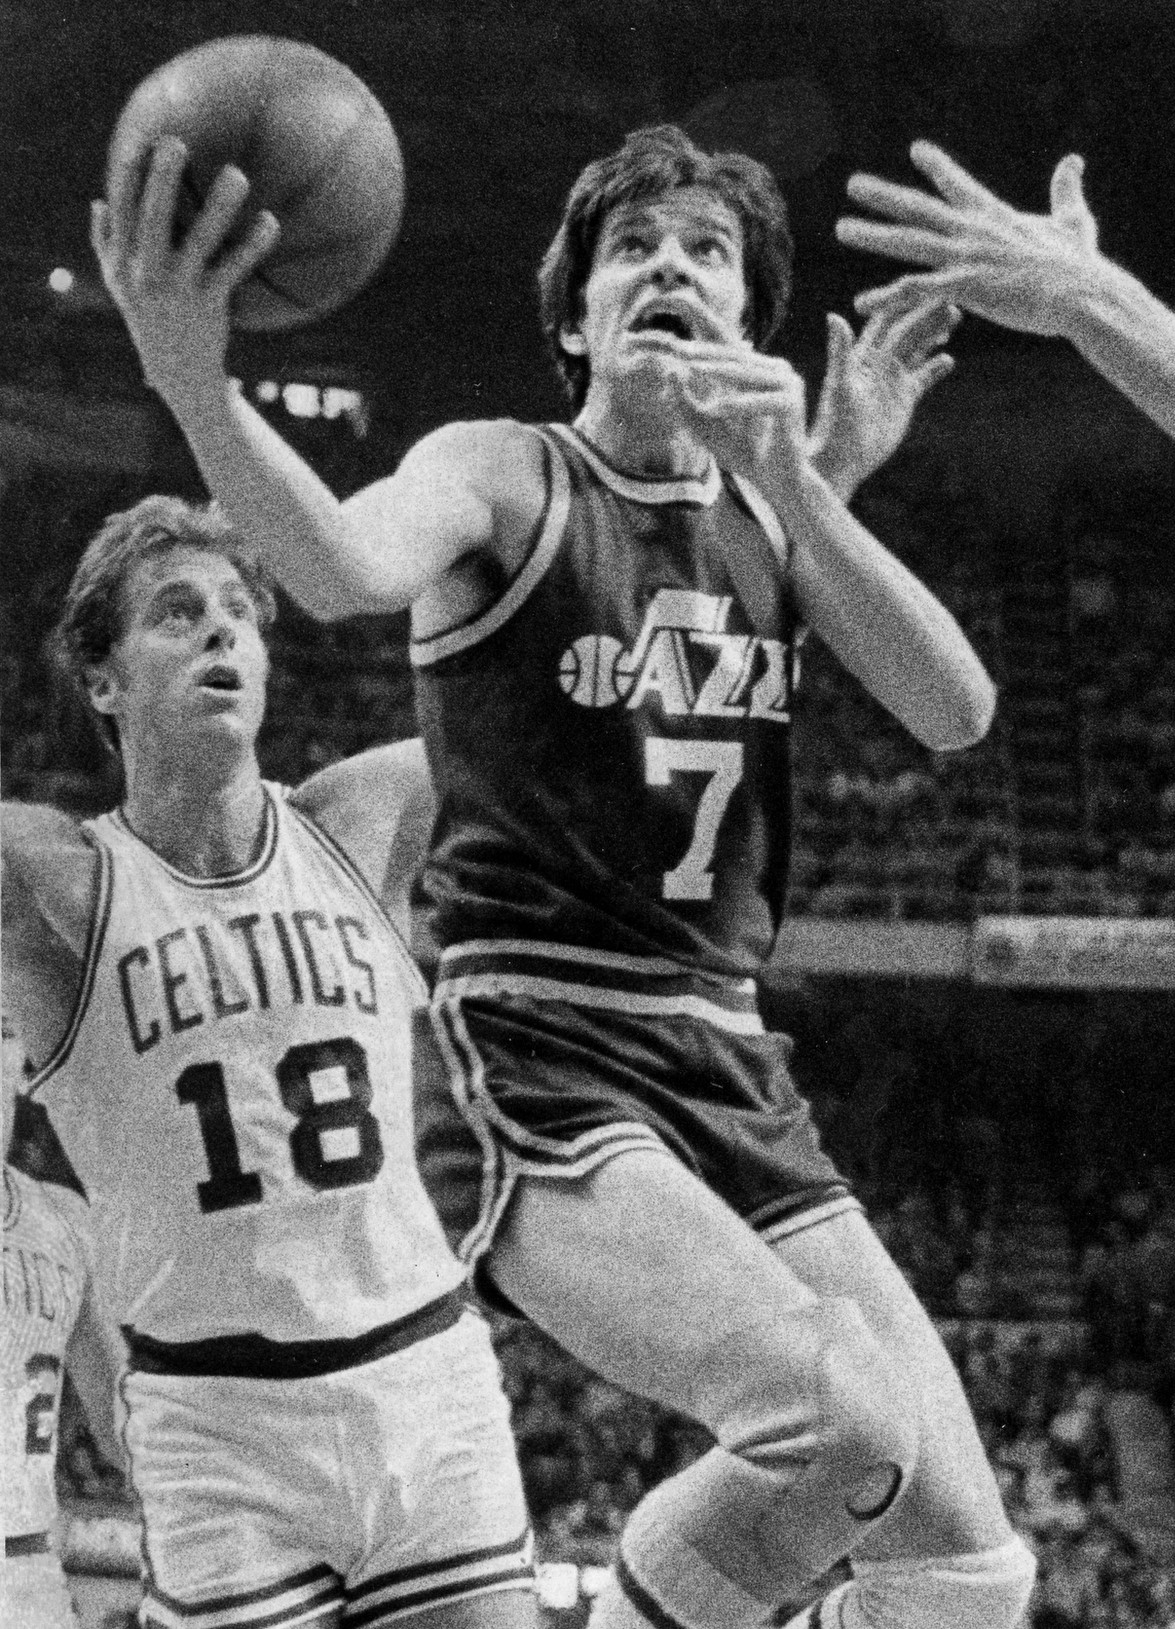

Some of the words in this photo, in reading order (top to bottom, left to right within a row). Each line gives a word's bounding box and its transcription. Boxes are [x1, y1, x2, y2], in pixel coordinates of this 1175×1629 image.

[645, 736, 744, 900] 7
[117, 909, 379, 1055] CELTICS
[175, 1036, 384, 1214] 18
